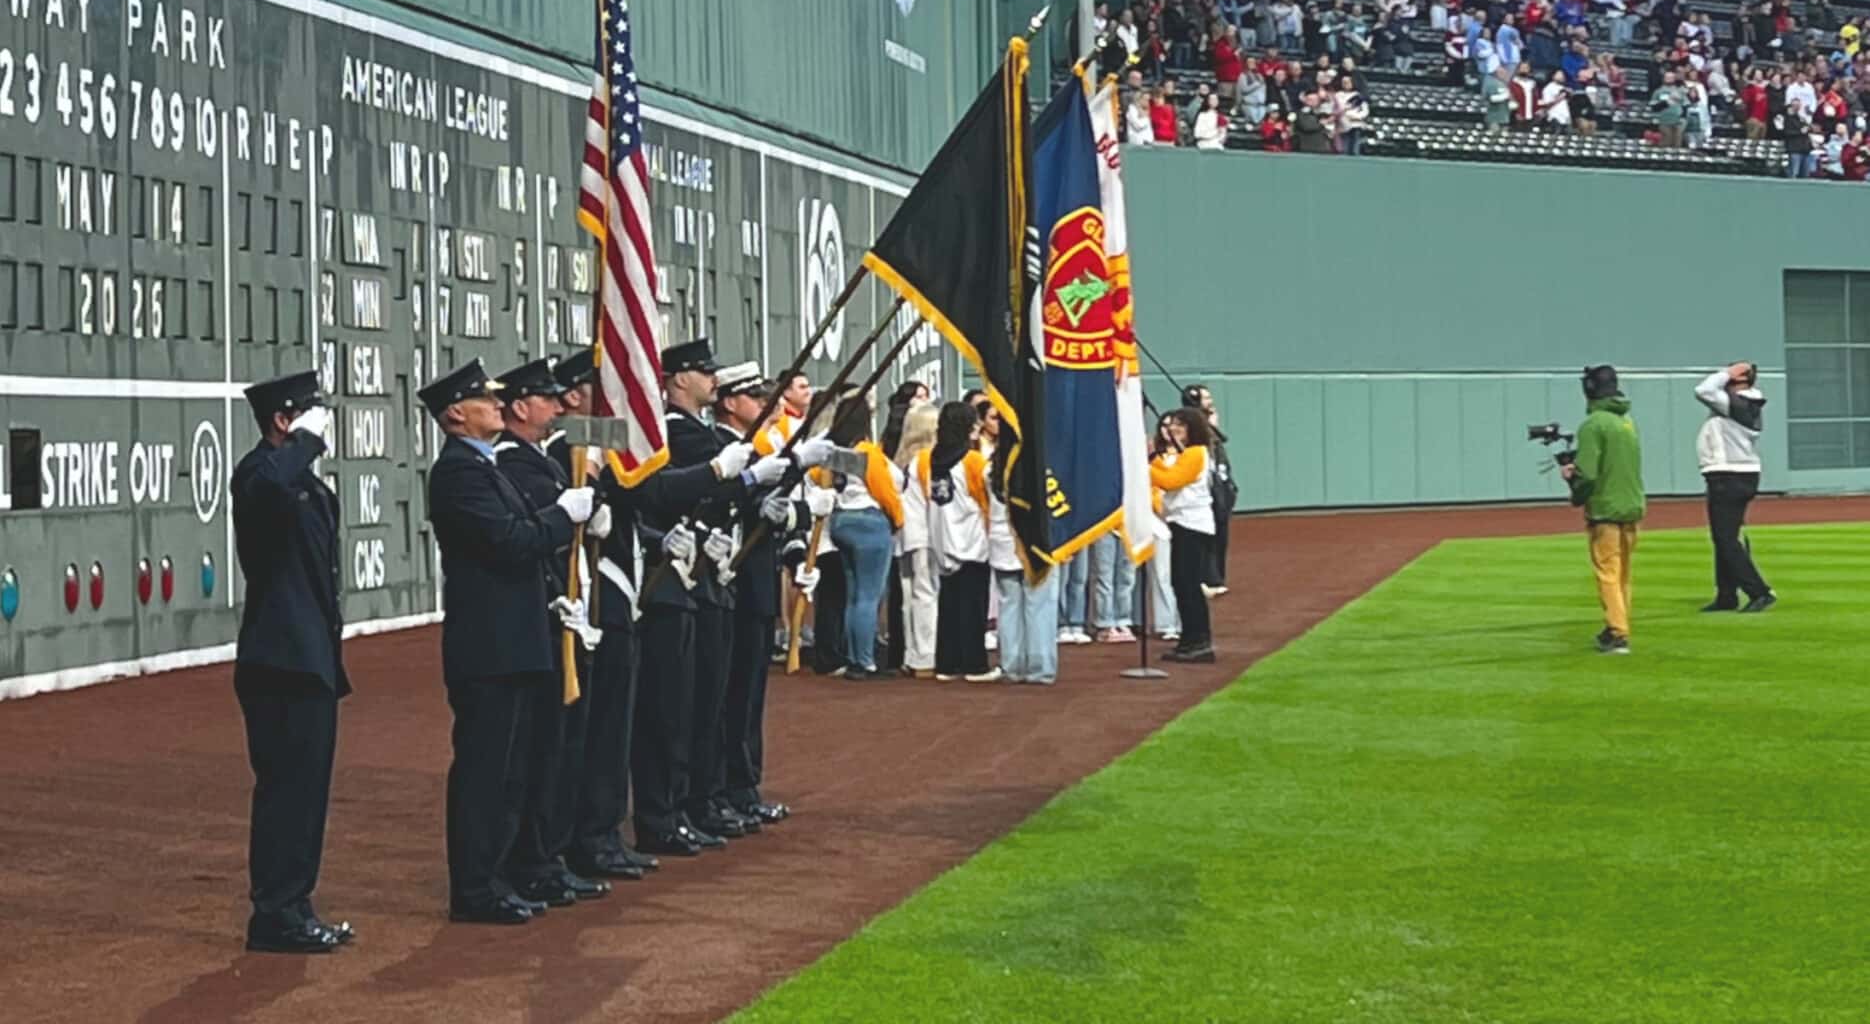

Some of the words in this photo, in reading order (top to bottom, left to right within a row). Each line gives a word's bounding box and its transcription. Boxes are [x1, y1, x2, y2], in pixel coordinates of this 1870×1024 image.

[341, 55, 437, 124] AMERICAN
[445, 85, 509, 141] LEAGUE
[321, 124, 333, 175] P
[57, 165, 114, 235] MAY
[153, 185, 184, 245] 14
[464, 235, 489, 280] STL
[81, 273, 163, 339] 2026
[352, 280, 380, 328] MIN
[465, 292, 490, 337] ATH
[354, 346, 384, 394] SEA
[1051, 338, 1113, 361] DEPT.
[353, 409, 384, 457] HOU
[41, 442, 118, 508] STRIKE
[129, 442, 174, 503] OUT
[359, 474, 381, 525] KC
[354, 540, 385, 590] CWS
